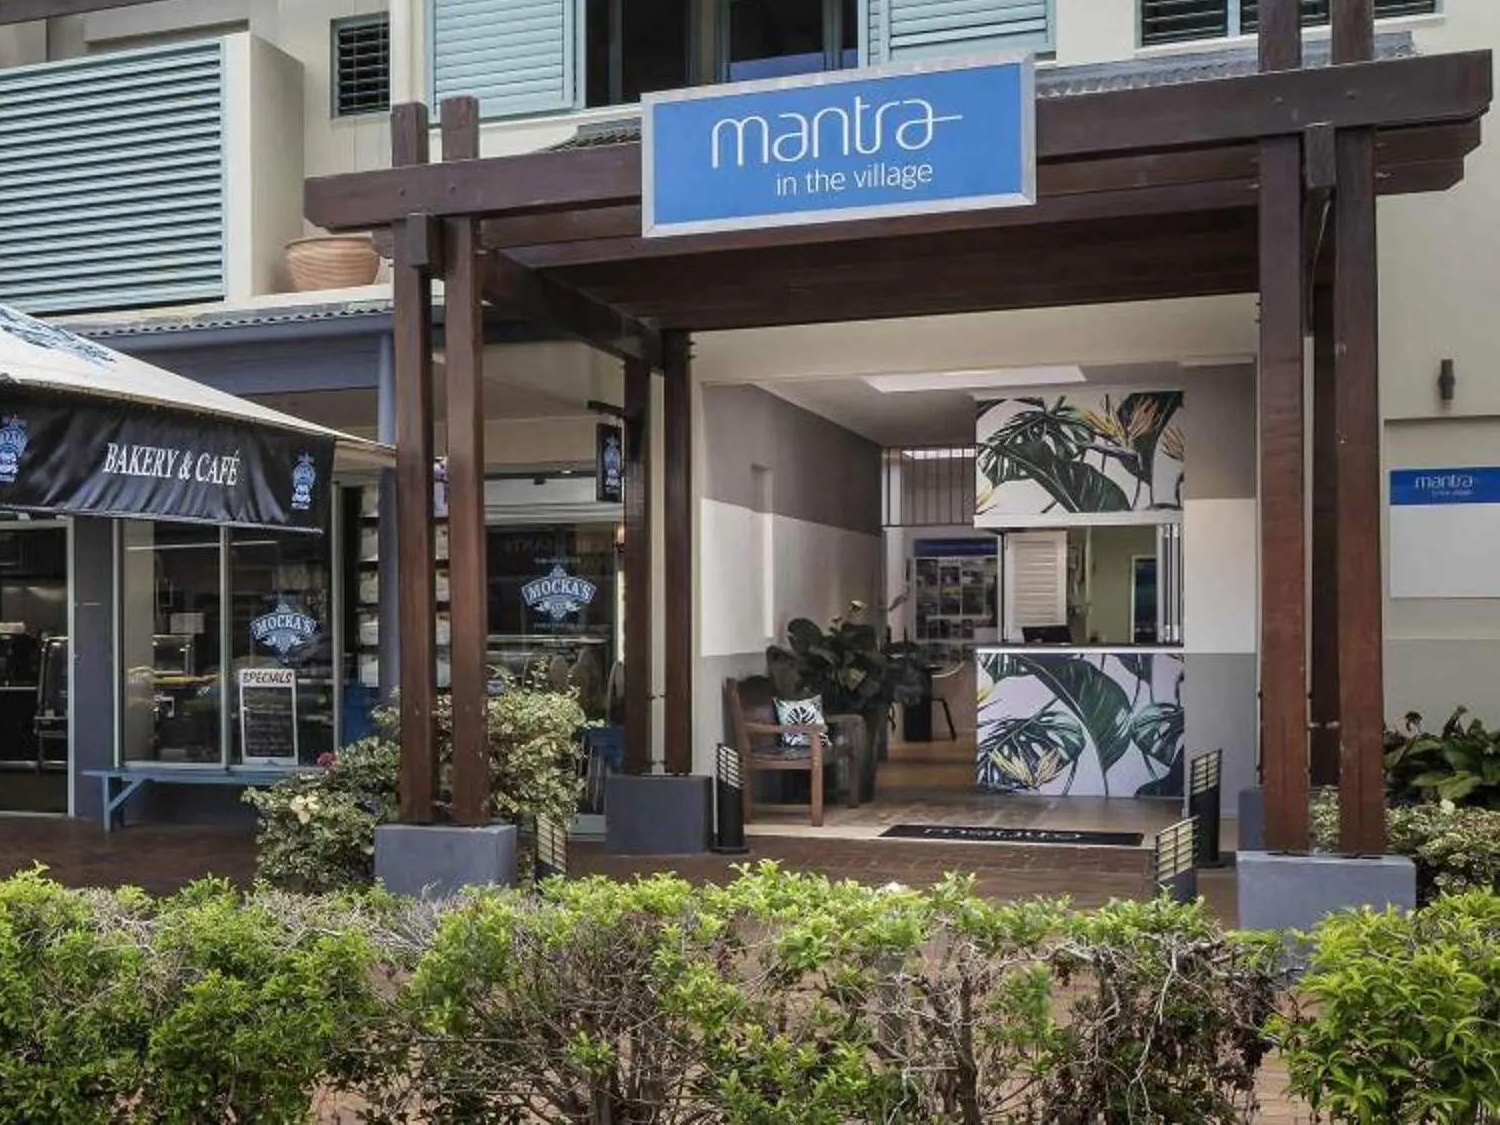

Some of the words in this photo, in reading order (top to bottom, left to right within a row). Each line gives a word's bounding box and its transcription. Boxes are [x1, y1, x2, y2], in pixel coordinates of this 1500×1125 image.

[712, 96, 964, 170] mantra
[776, 174, 797, 196] in
[806, 168, 846, 194] the
[853, 162, 934, 190] village
[102, 442, 179, 478] BAKERY
[178, 450, 194, 480] &
[195, 449, 241, 486] CAFÉ
[1415, 474, 1475, 489] mantra
[528, 579, 592, 602] MOCKA'S
[256, 614, 314, 637] MOCKA'S
